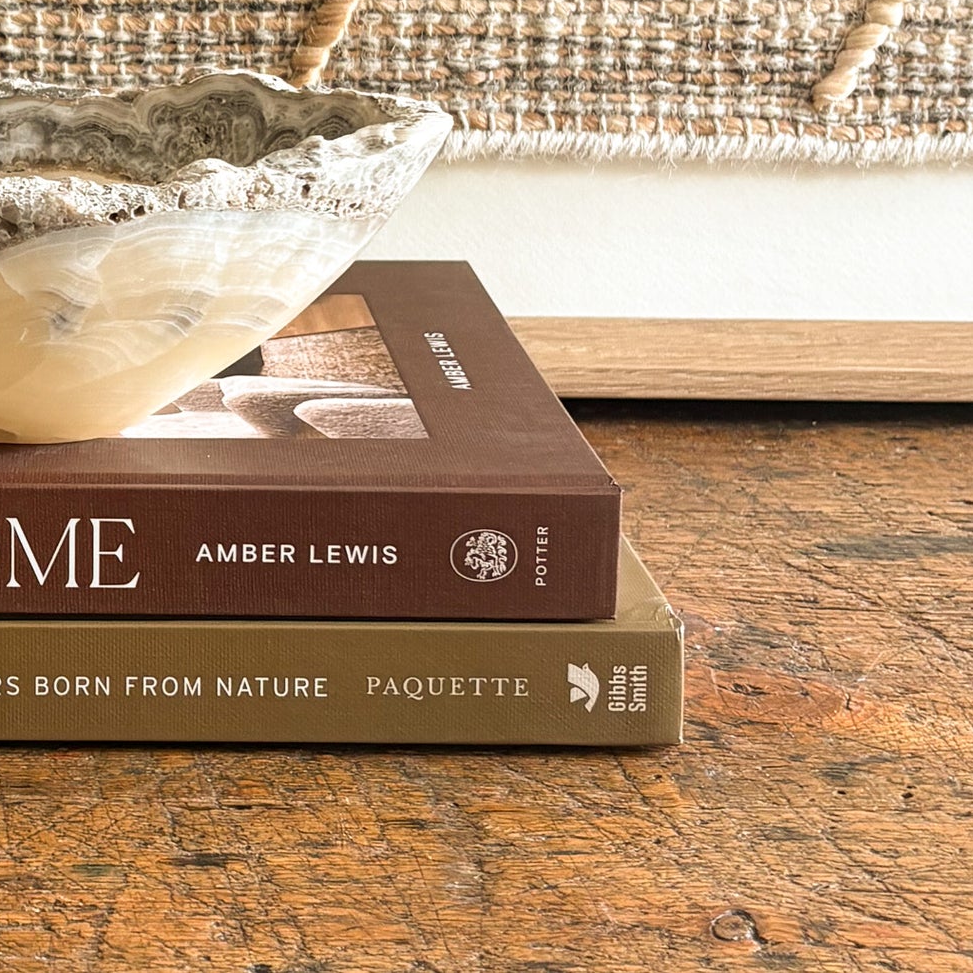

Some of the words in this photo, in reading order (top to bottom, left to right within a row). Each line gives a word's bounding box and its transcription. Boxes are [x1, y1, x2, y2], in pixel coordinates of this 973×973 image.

[423, 332, 455, 358] LEWIS
[438, 359, 472, 390] AMBER
[195, 543, 295, 563] AMBER
[309, 544, 398, 565] LEWIS
[535, 526, 549, 587] POTTER
[35, 676, 110, 696] BORN
[125, 676, 202, 696] FROM
[217, 677, 328, 698] NATURE
[366, 676, 529, 701] PAQUETTE
[608, 665, 627, 712] Gibbs
[628, 665, 648, 712] Smith
